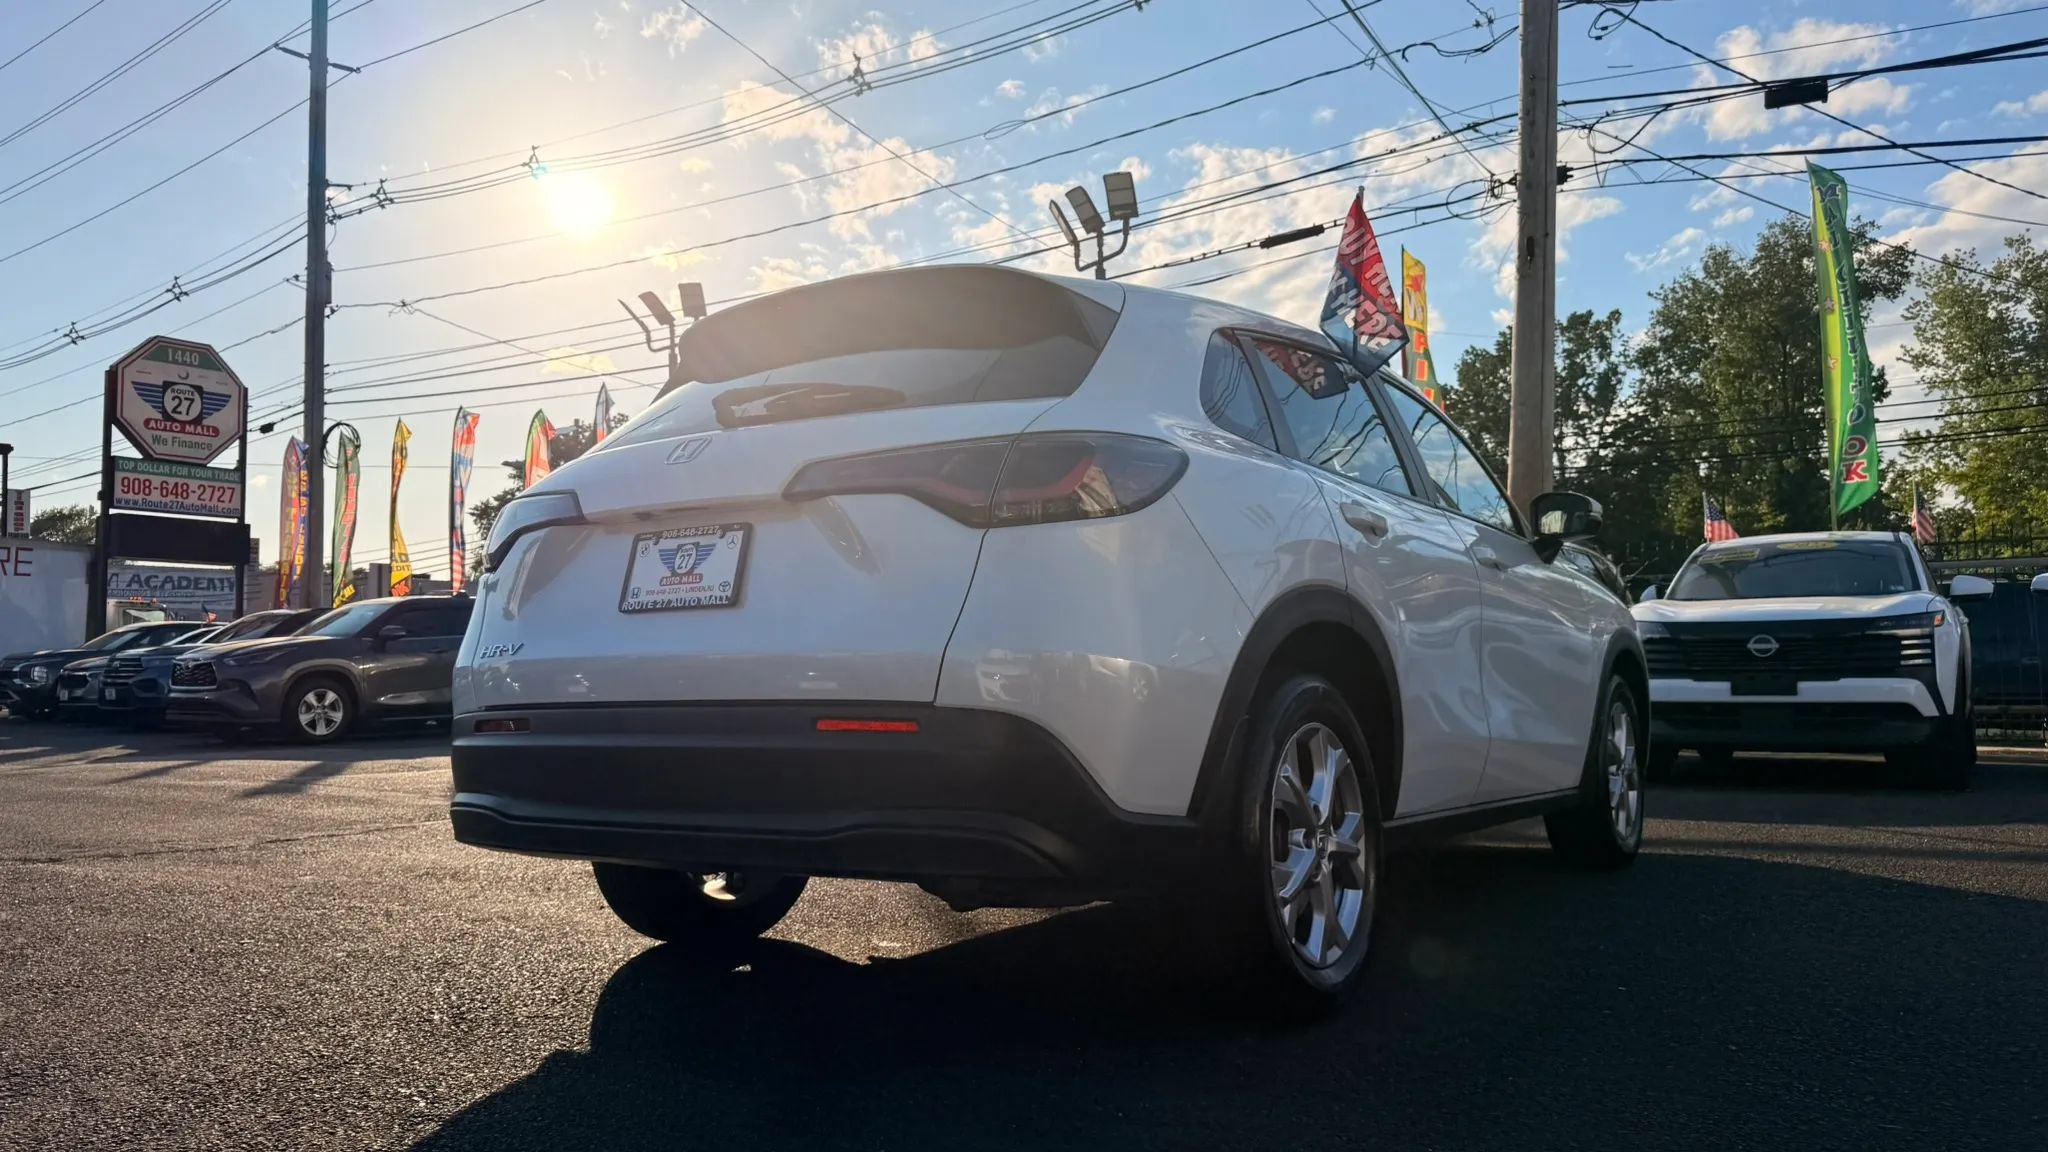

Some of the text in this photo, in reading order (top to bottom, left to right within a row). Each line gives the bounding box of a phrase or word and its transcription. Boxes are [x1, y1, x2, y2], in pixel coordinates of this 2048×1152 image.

[167, 348, 199, 365] 1440
[170, 387, 195, 397] ROUTE
[170, 395, 196, 416] 27
[148, 419, 216, 436] AUTO MALL
[151, 433, 213, 451] We Finance
[119, 460, 240, 481] TOP DOLLAR FOR YOUR TRADE
[120, 476, 236, 504] 908-648-2727
[115, 498, 240, 515] www.Route27AutoMall.com
[676, 553, 693, 570] 27
[662, 575, 701, 586] AUTO MALL
[621, 594, 729, 611] ROUTE 27 AUTO MALL
[480, 643, 524, 659] HR-V
